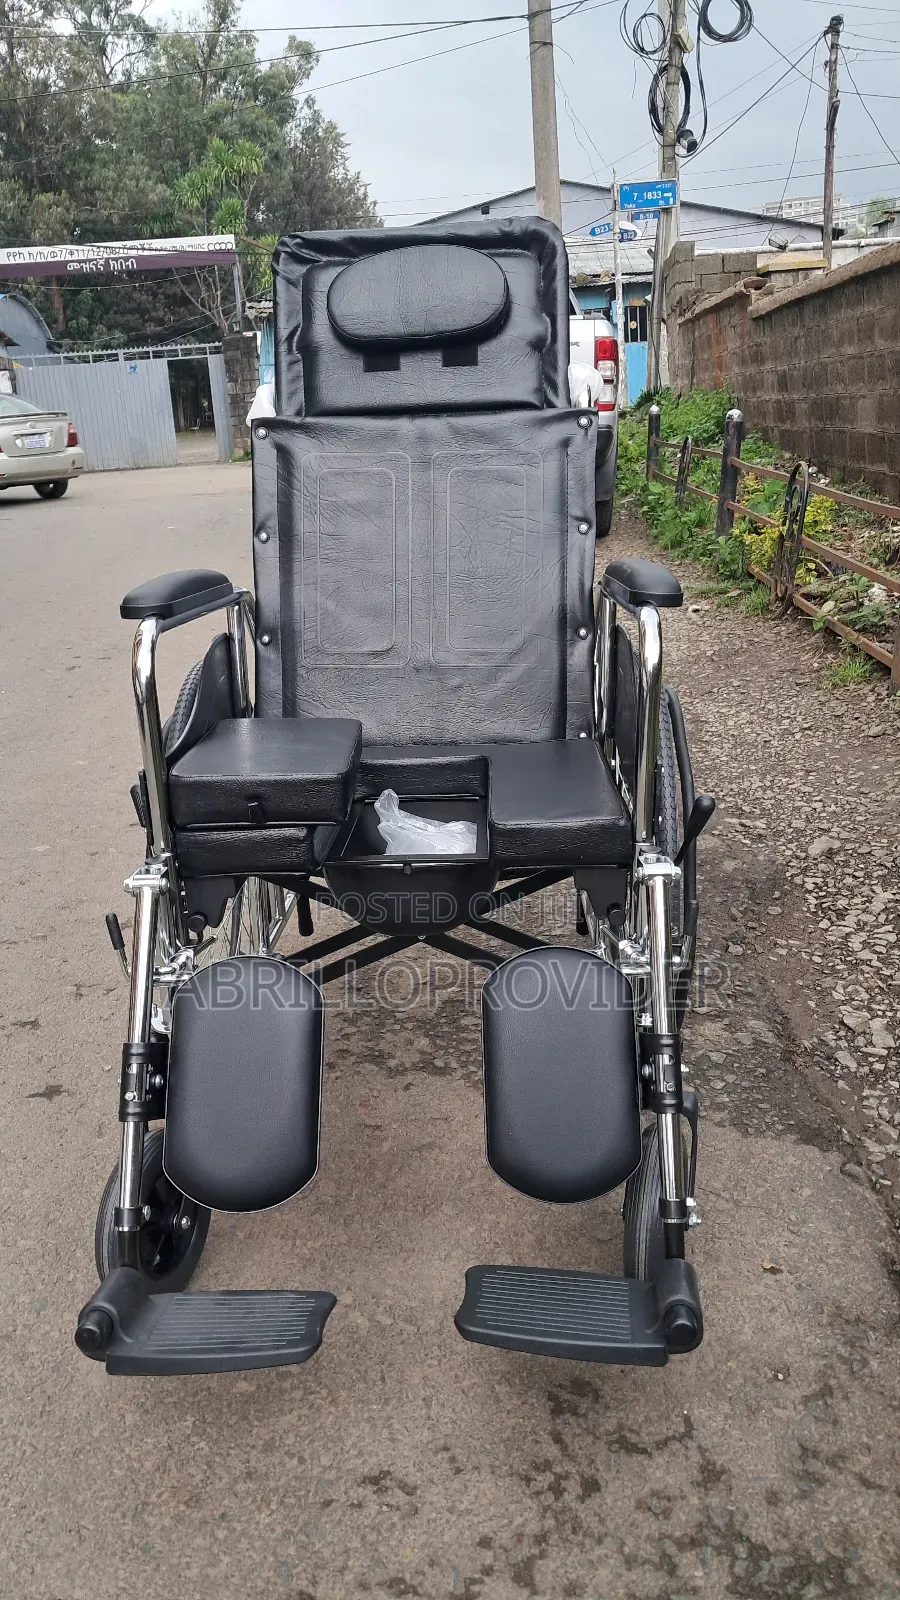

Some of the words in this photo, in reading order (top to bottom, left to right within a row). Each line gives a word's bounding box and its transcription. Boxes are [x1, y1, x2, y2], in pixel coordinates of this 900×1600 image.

[633, 191, 662, 203] 7_1833
[594, 225, 609, 235] B23
[623, 231, 635, 239] B22
[6, 250, 26, 262] የየካ
[66, 258, 105, 273] መዝናኛ
[109, 258, 137, 271] ክበብ
